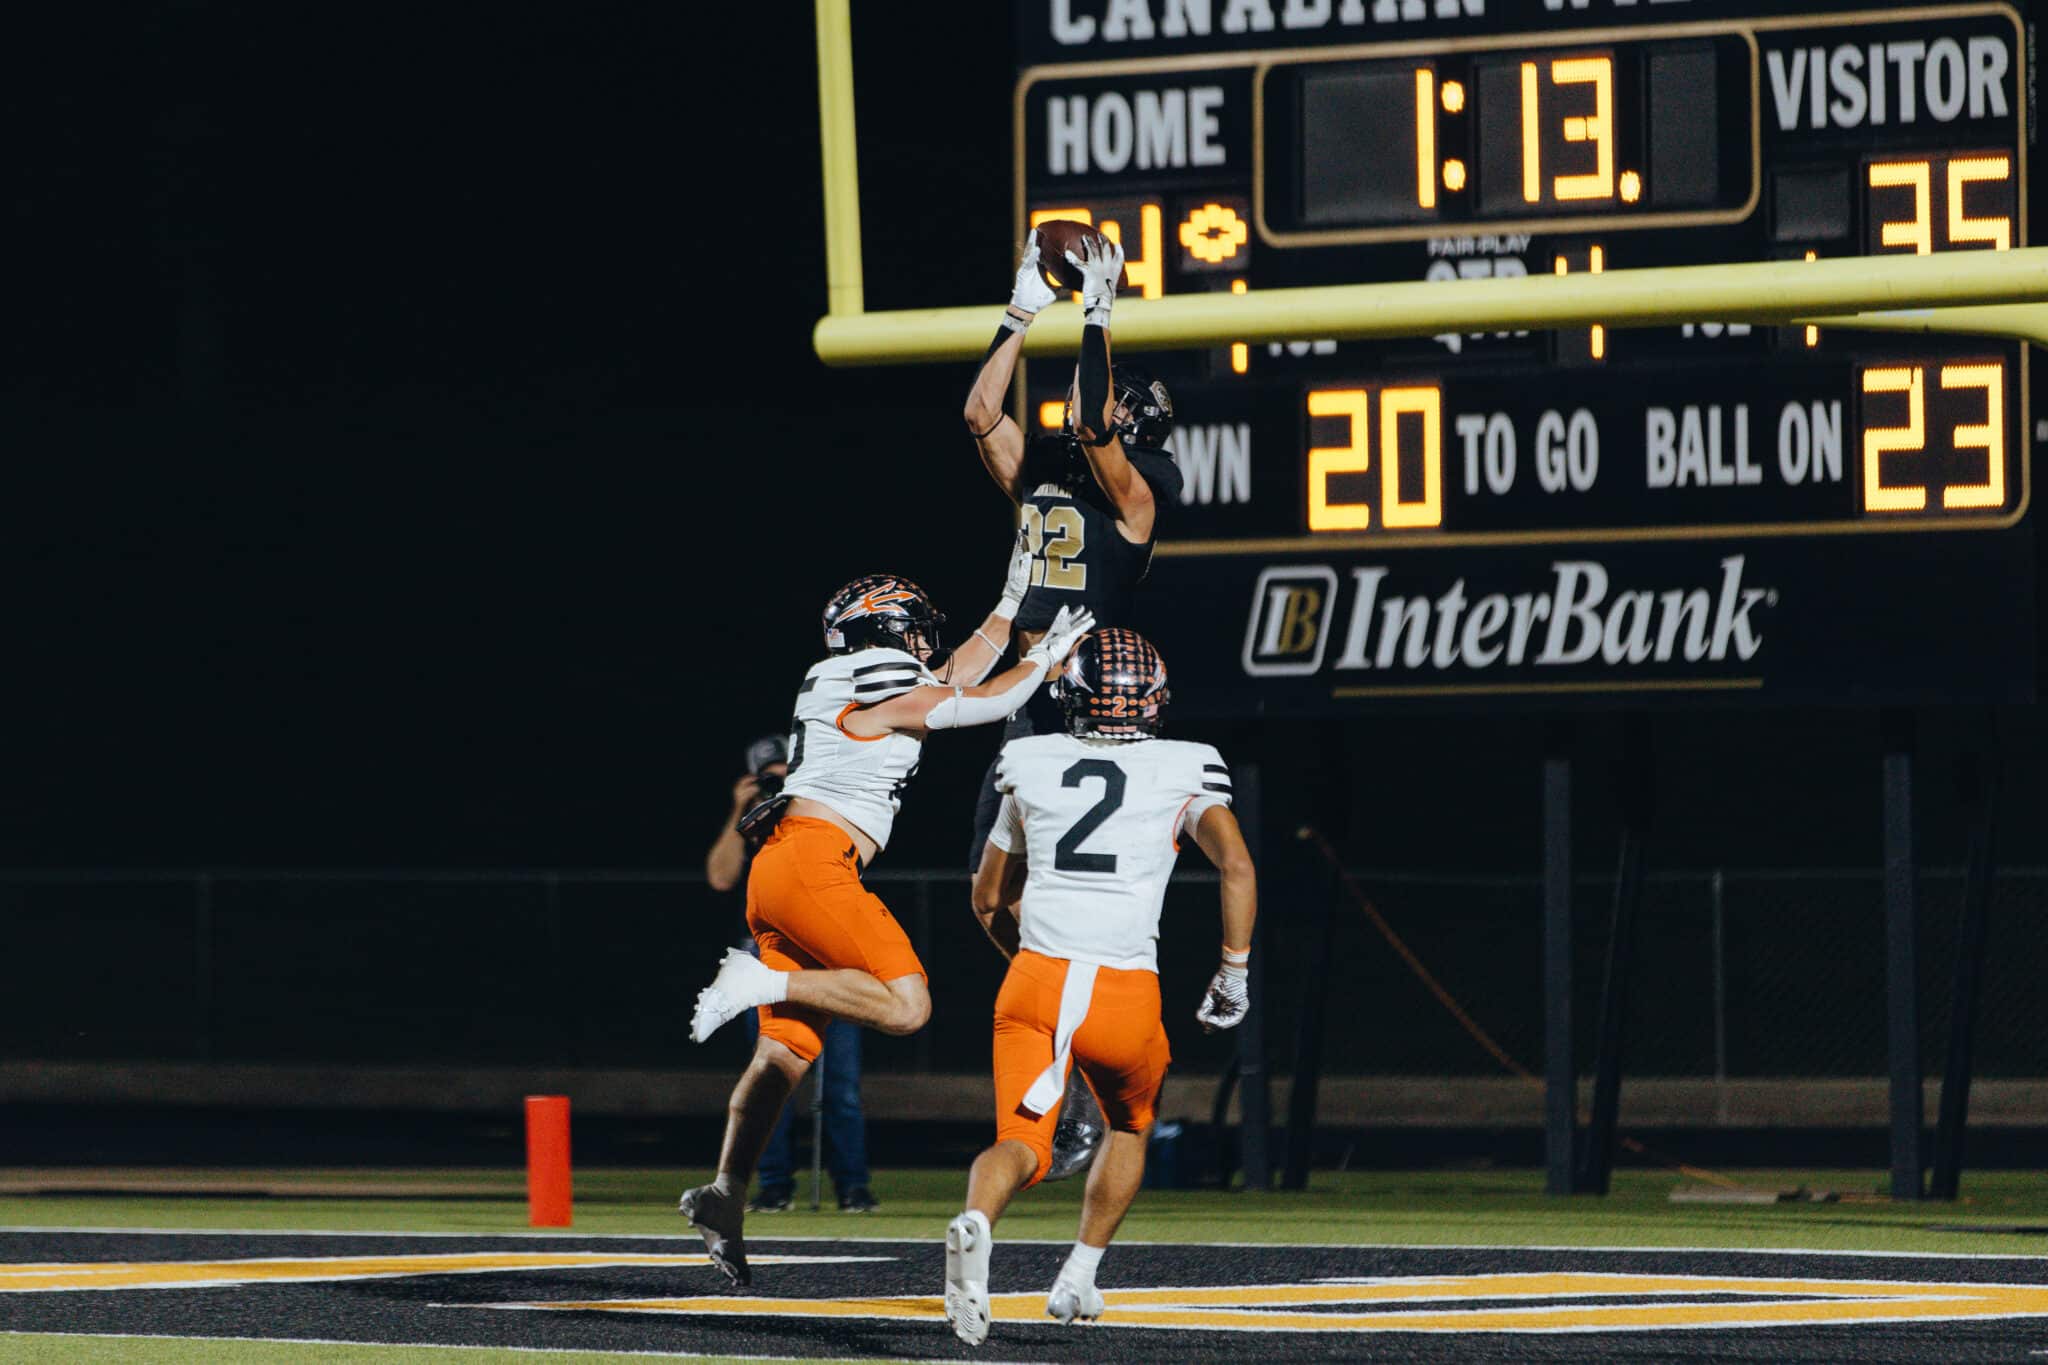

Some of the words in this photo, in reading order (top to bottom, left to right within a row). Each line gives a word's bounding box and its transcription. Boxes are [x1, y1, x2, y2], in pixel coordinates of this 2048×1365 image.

[1766, 35, 2009, 131] VISITOR
[1047, 86, 1227, 175] HOME
[1161, 422, 1251, 504] WN
[1307, 385, 1442, 532] 20
[1456, 413, 1517, 495] TO
[1535, 408, 1600, 493] GO
[1645, 403, 1763, 488] BALL
[1777, 400, 1843, 485] ON
[1862, 363, 2005, 512] 23
[1111, 695, 1128, 717] 2
[1054, 757, 1127, 874] 2
